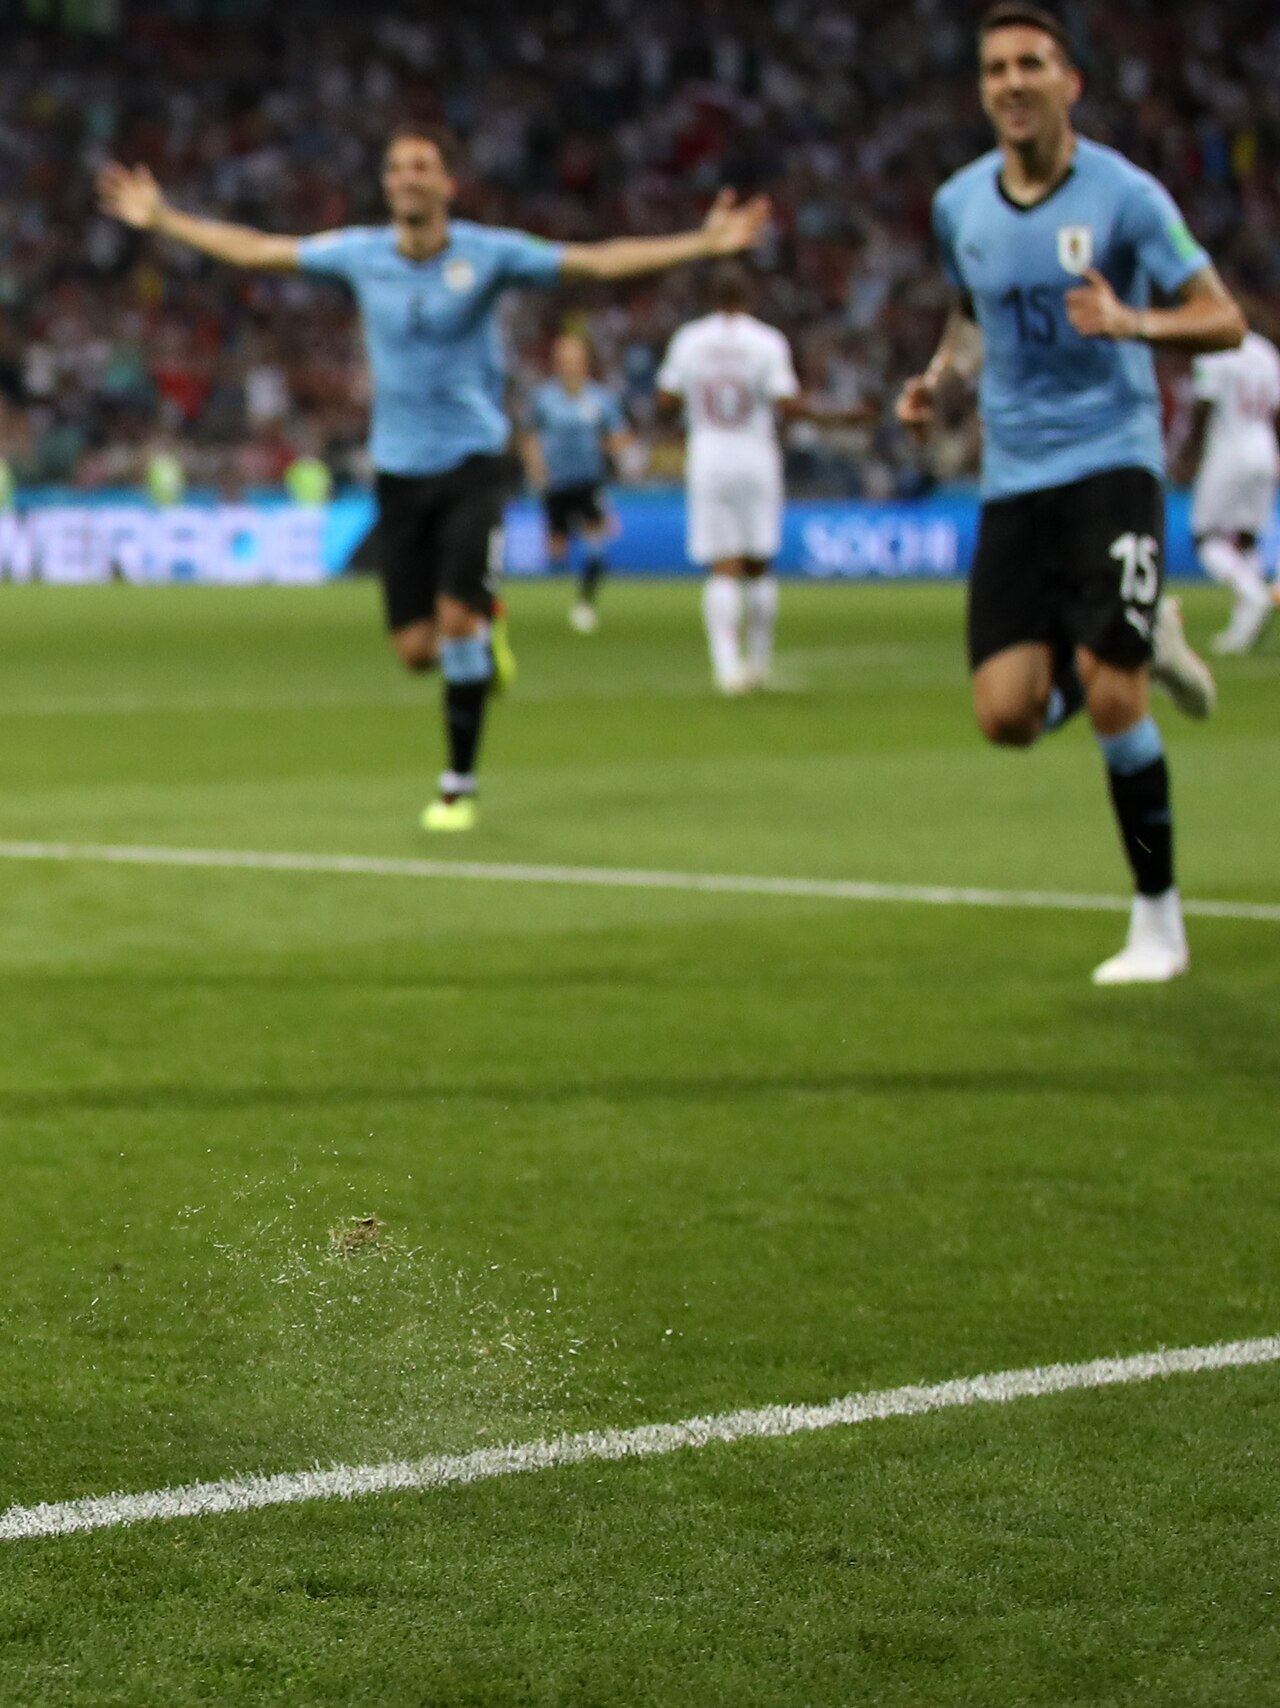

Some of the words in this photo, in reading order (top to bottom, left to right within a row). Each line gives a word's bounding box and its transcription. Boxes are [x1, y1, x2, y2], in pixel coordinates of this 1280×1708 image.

[1001, 286, 1057, 345] 15
[803, 515, 958, 577] SOCHI
[1109, 533, 1158, 605] 15
